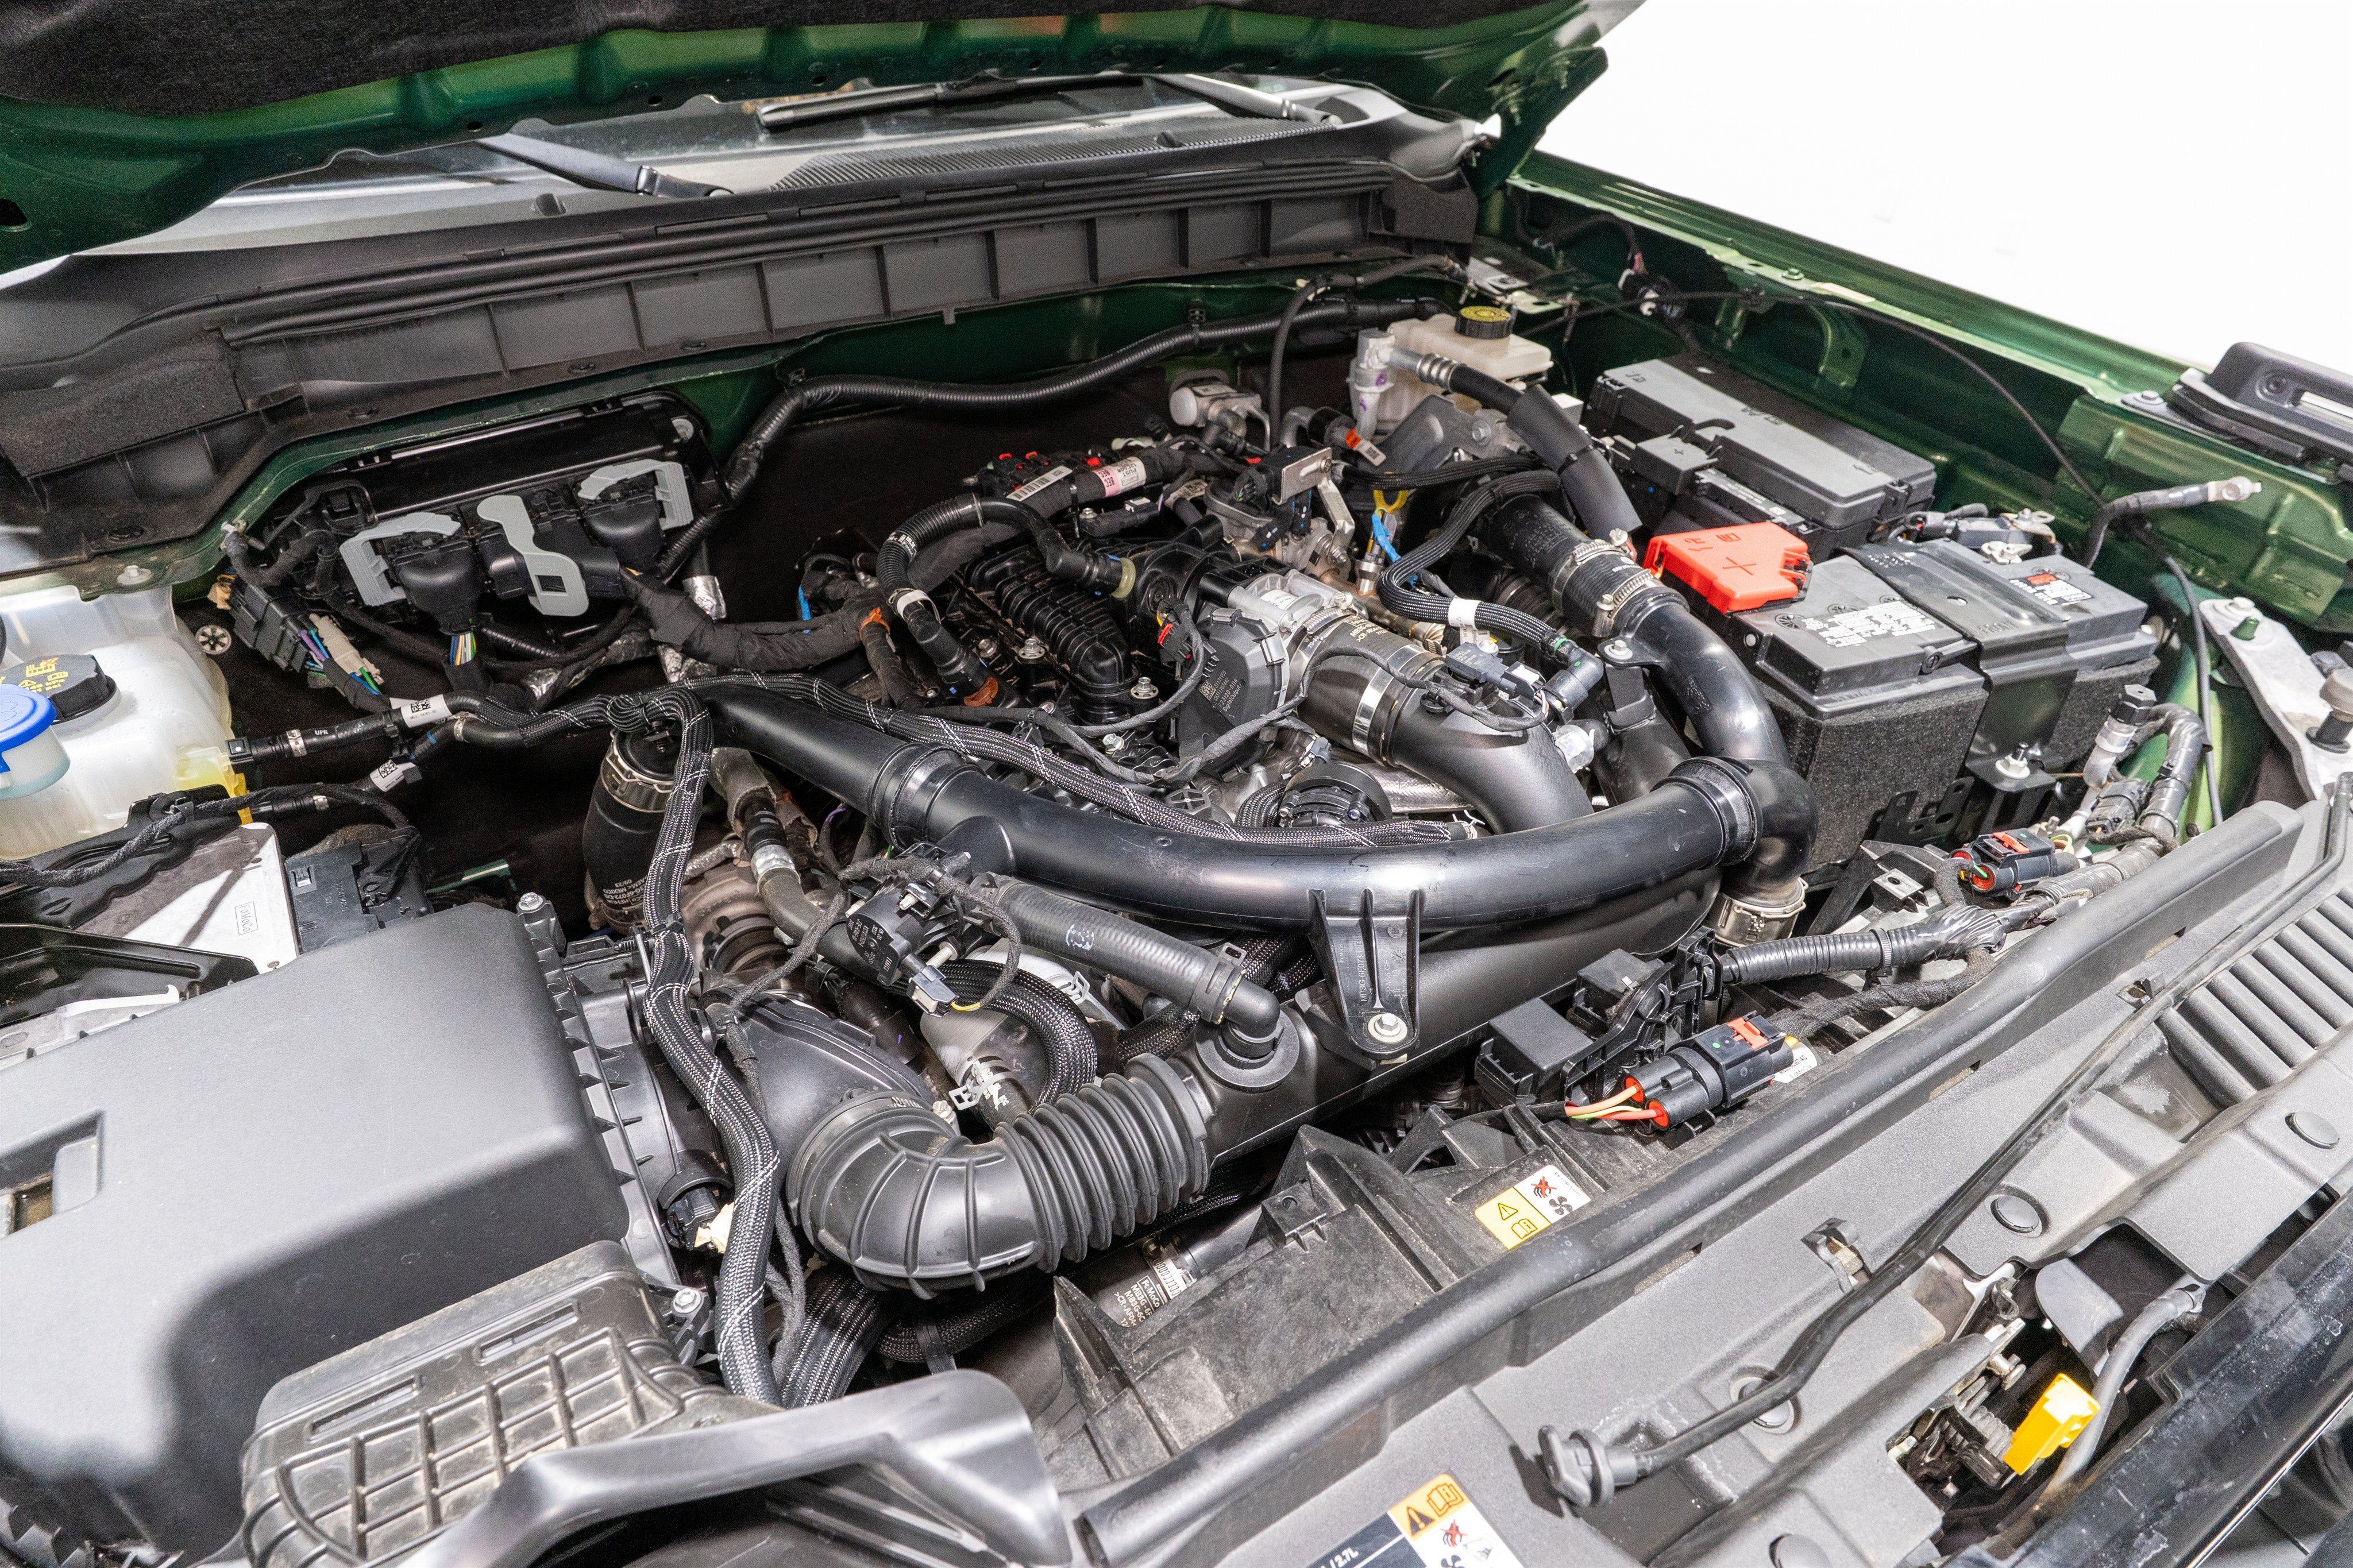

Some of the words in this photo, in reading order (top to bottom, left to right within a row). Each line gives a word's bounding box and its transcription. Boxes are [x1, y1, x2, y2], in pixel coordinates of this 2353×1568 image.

[1104, 477, 1115, 488] BEC
[603, 886, 627, 895] MEXICO
[240, 904, 251, 933] FoMoCo
[1141, 1279, 1160, 1308] FoMoCo
